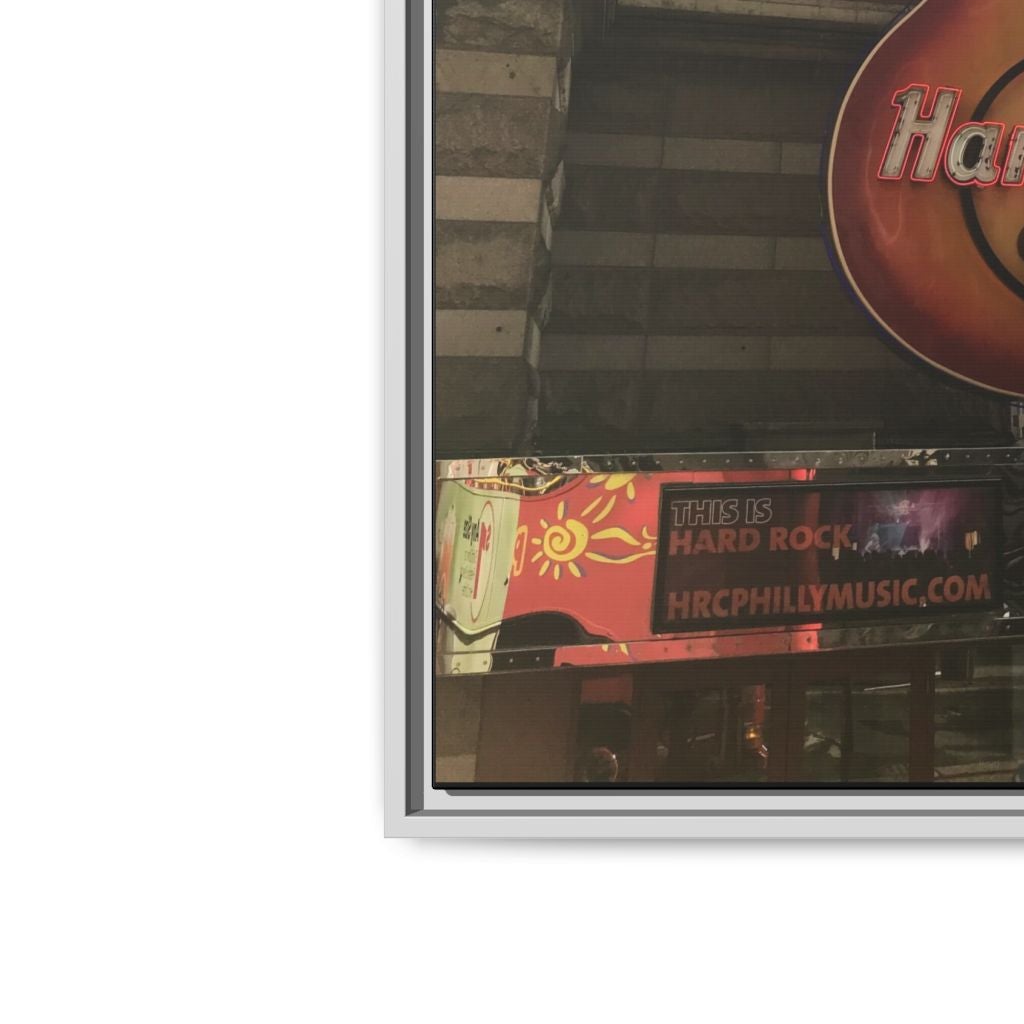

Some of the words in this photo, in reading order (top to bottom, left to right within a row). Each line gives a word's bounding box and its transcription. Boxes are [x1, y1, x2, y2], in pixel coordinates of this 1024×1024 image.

[671, 499, 740, 526] THIS
[745, 498, 773, 524] IS
[668, 527, 761, 556] HARD
[667, 572, 992, 621] HRCPHILLYMUSIC.COM
